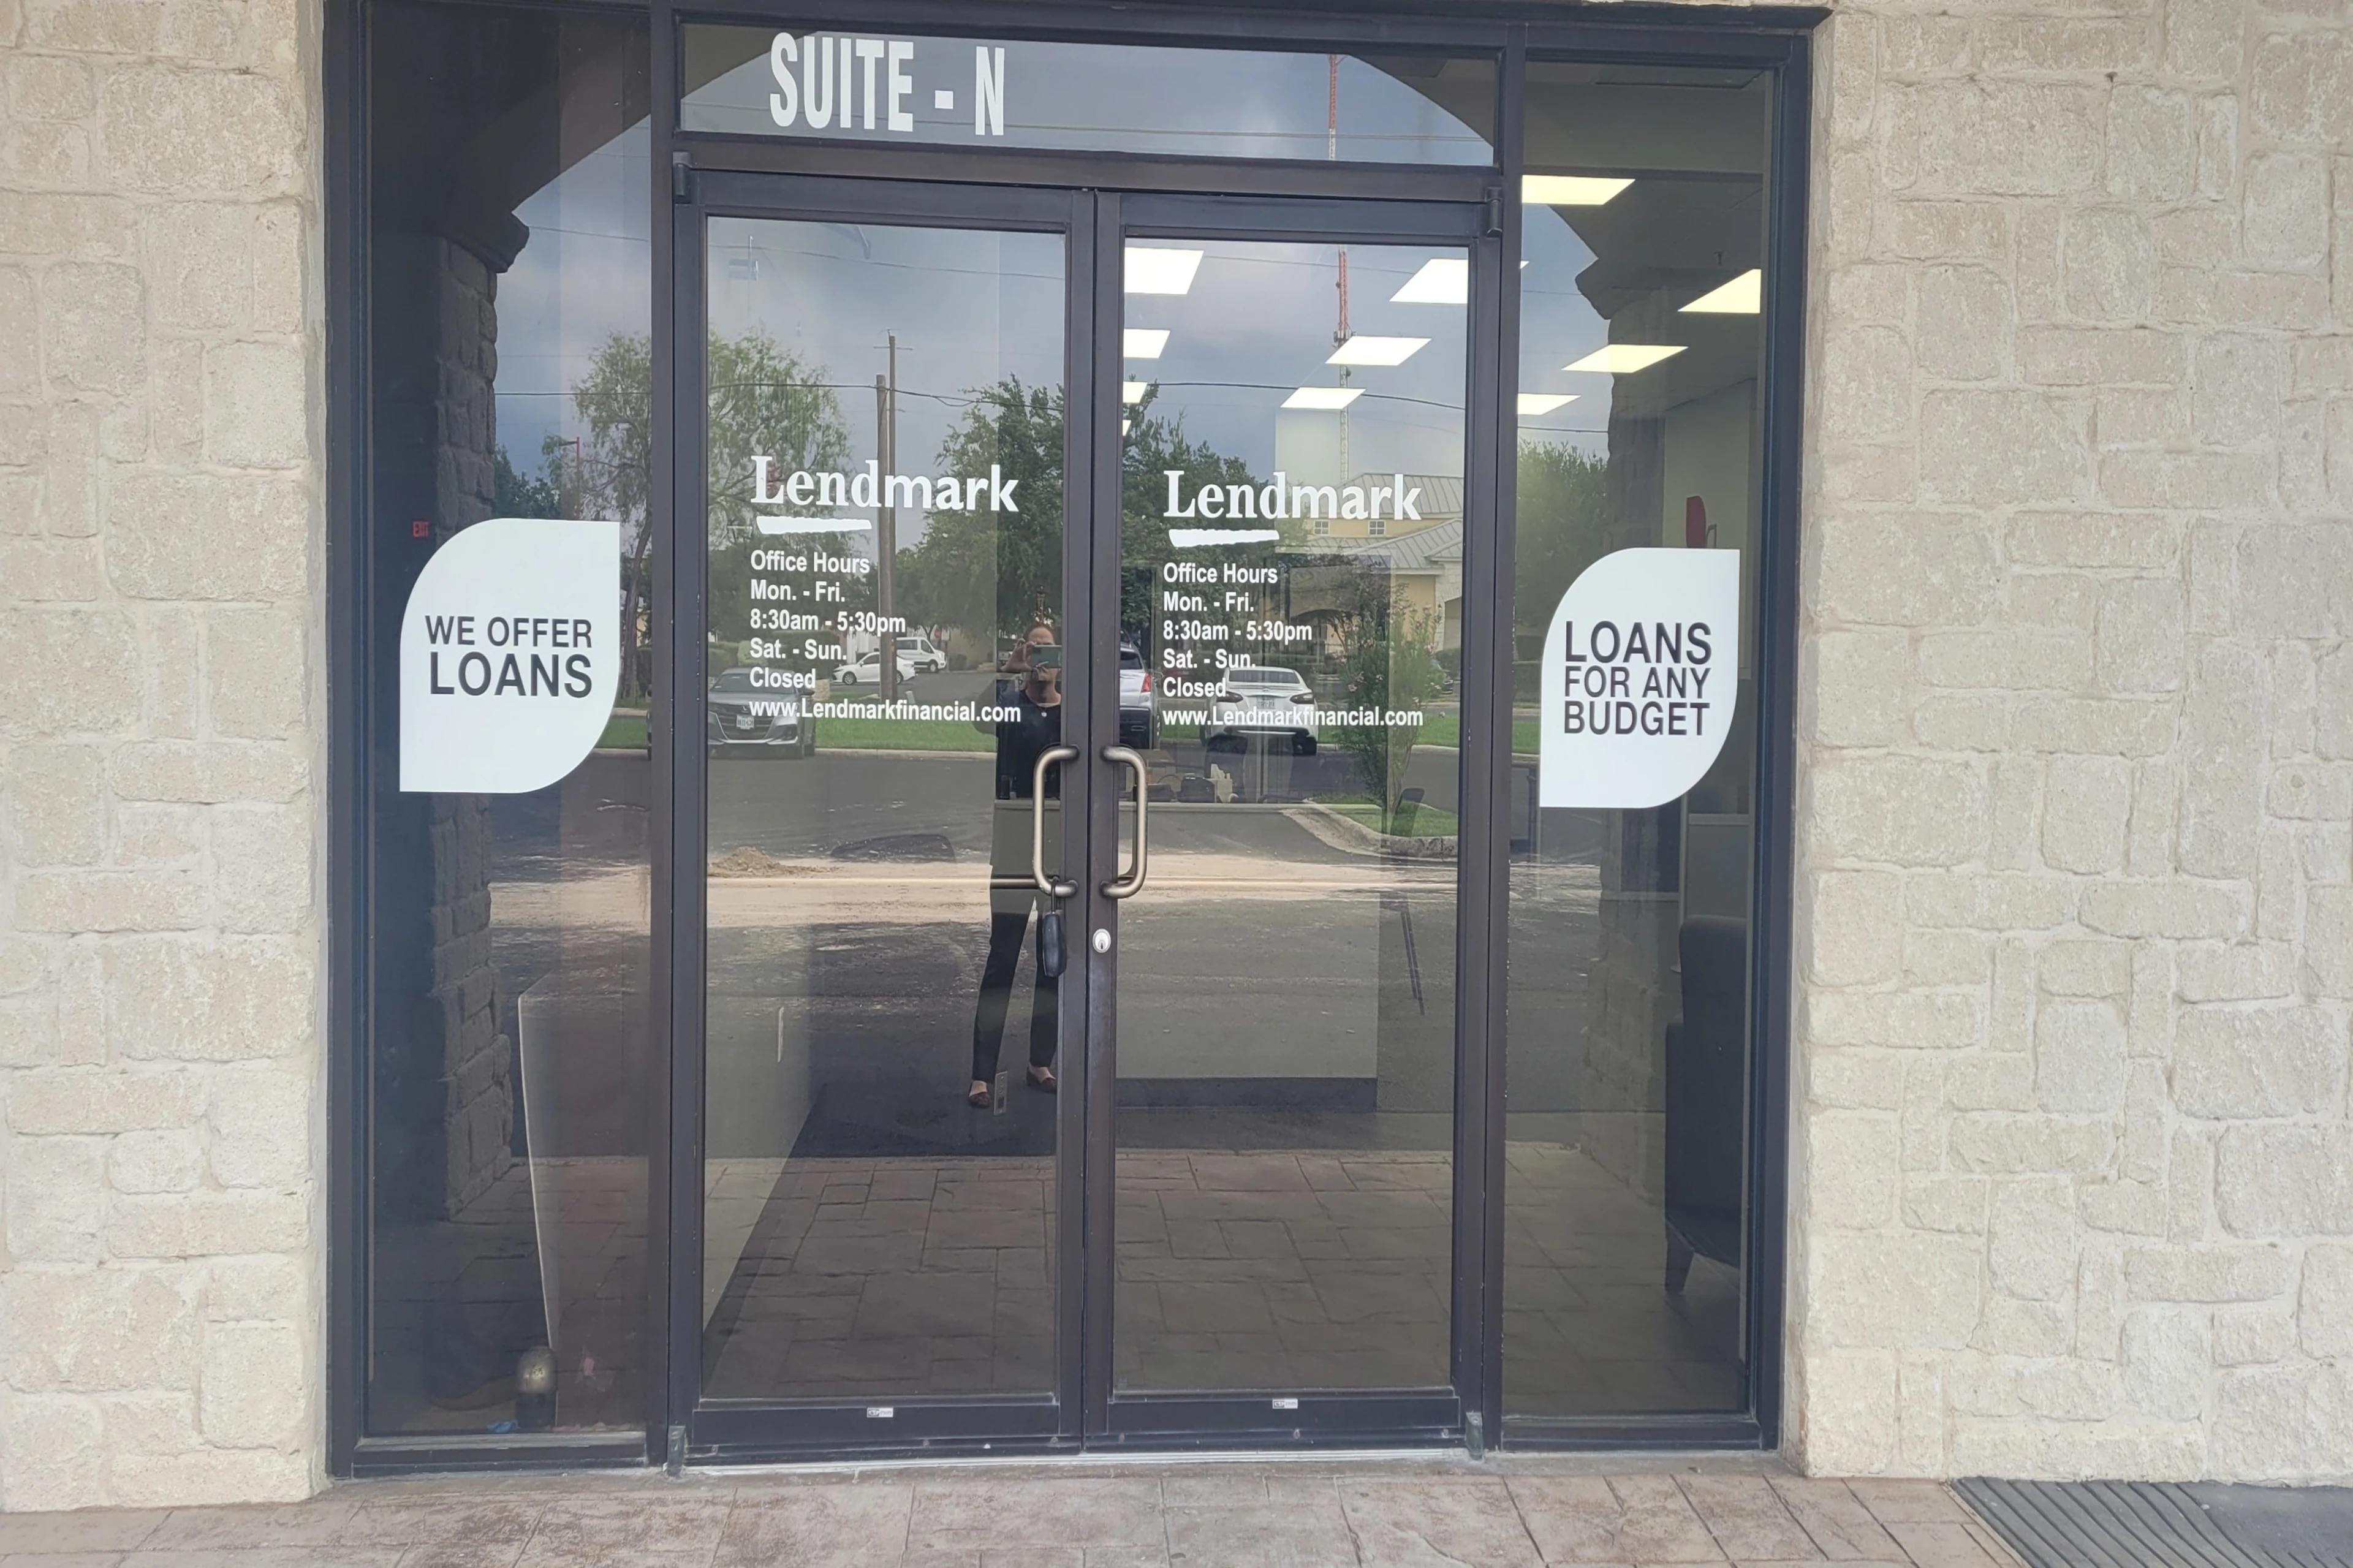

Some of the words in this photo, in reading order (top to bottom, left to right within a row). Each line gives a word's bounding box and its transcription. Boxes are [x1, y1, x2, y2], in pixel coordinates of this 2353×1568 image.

[770, 32, 914, 132] SUITE
[976, 46, 1005, 135] N
[750, 456, 1018, 512] Lendmark
[1164, 471, 1422, 520] Lendmark
[751, 550, 807, 571] Office
[814, 552, 870, 573] Hours
[1164, 562, 1218, 583] Office
[1224, 563, 1278, 583] Hours
[751, 580, 797, 600] Mon.
[816, 581, 845, 602] Fri.
[1164, 591, 1207, 612] Mon.
[1226, 592, 1254, 612] Fri.
[425, 615, 475, 645] WE
[488, 616, 592, 648] OFFER
[750, 609, 819, 630] 8:30am
[837, 612, 906, 637] 5:30pm
[1163, 620, 1228, 640] 8:30am
[1246, 621, 1312, 645] 5:30pm
[750, 638, 786, 658] Sat.
[805, 639, 846, 660] Sun.
[1566, 621, 1711, 665] LOANS
[1163, 648, 1197, 668] Sat.
[1215, 649, 1256, 668] Sun.
[430, 651, 592, 698] LOANS
[749, 667, 816, 688] Closed
[1564, 665, 1630, 697] FOR
[1642, 667, 1711, 699] ANY
[1163, 677, 1226, 697] Closed
[749, 698, 1021, 722] www.Lendmarkfinancial.com
[1162, 706, 1423, 726] www.Lendmarkfinancial.com
[1564, 700, 1710, 736] BUDGET
